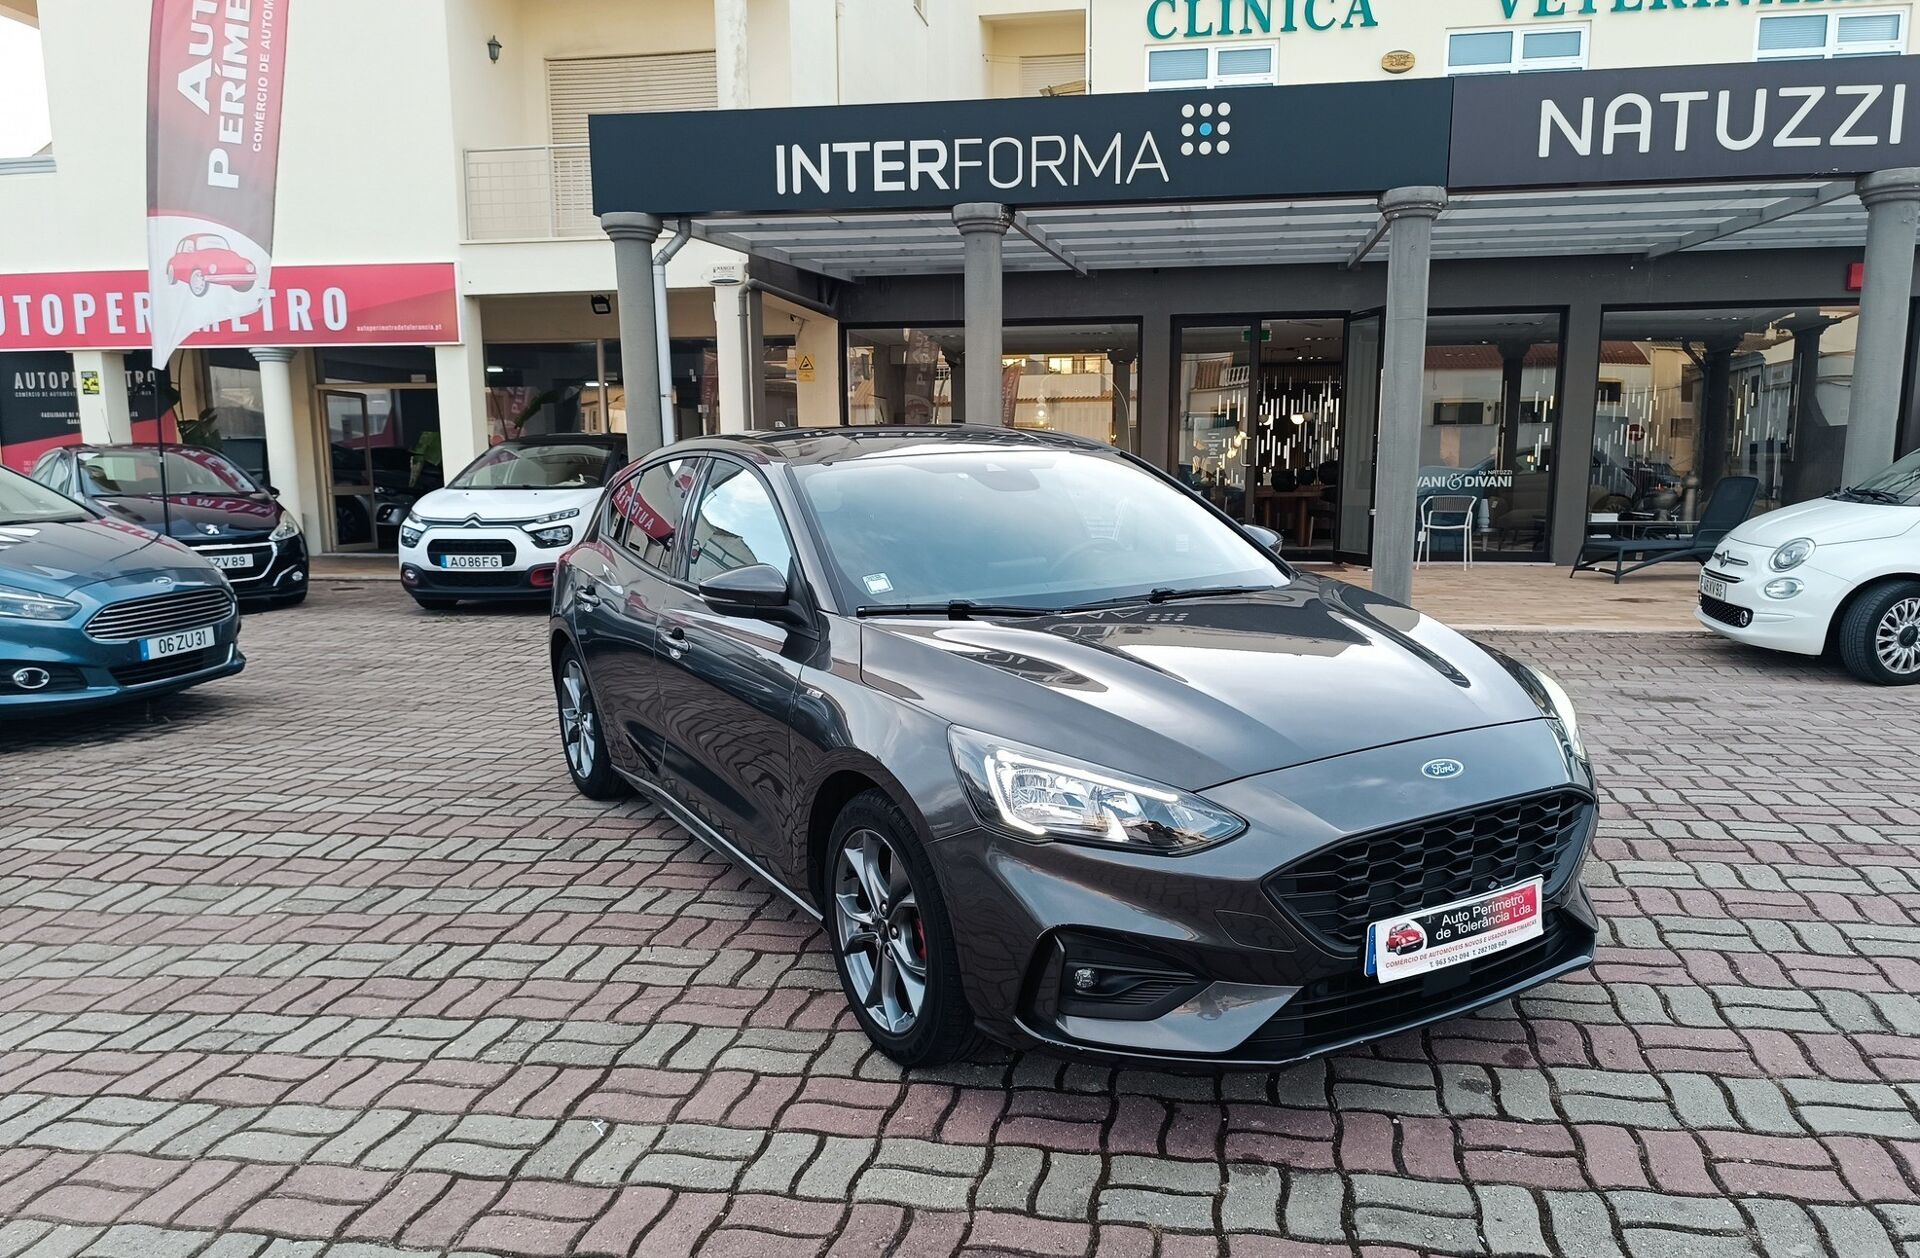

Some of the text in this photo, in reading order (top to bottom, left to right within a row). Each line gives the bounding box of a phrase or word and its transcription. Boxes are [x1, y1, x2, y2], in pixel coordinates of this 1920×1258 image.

[259, 53, 270, 73] DE
[252, 77, 269, 152] COMÉRCIO
[1538, 83, 1906, 158] NATUZZI
[775, 130, 1170, 195] INTERFORMA
[1447, 473, 1465, 491] &
[1464, 476, 1512, 488] DIVANI
[1431, 762, 1455, 775] Ford
[1436, 904, 1533, 940] de Tolerância Lda.
[1441, 895, 1524, 926] Auto Perímetro
[1420, 953, 1428, 961] DE
[1464, 938, 1482, 948] NOVOS
[1488, 930, 1507, 941] USADOS
